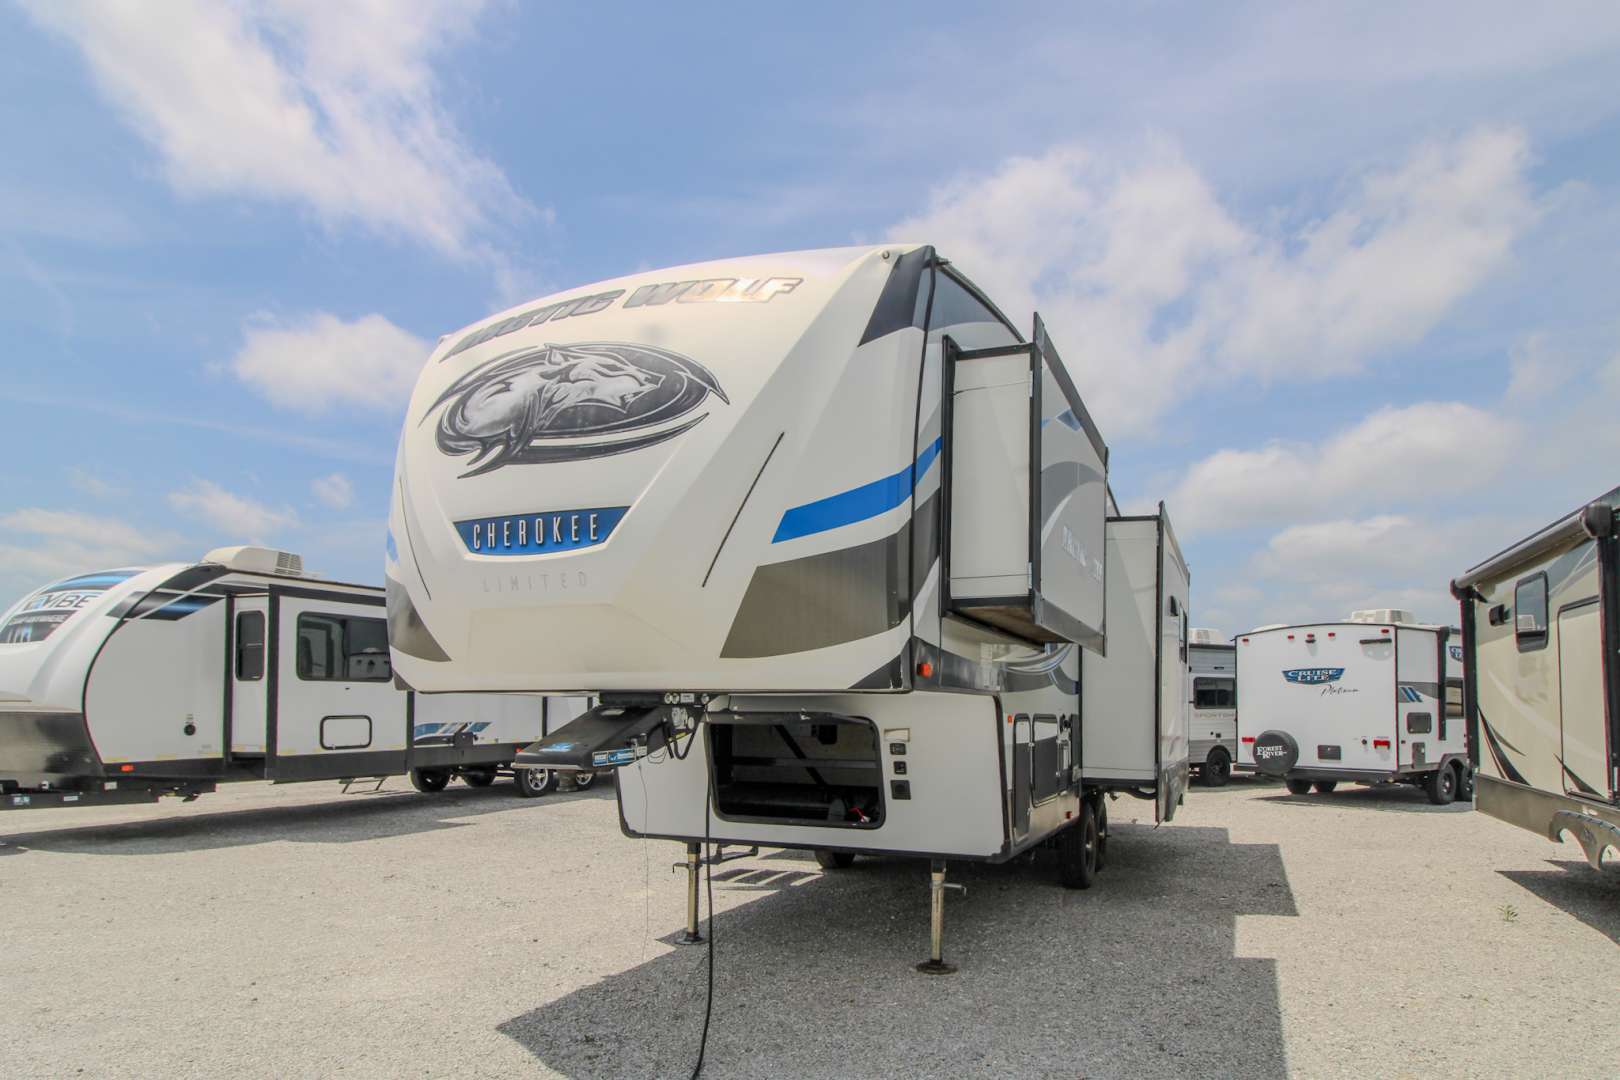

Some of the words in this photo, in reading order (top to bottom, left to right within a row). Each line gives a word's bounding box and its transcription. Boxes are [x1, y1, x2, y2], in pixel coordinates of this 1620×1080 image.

[622, 277, 804, 309] WOLF
[473, 513, 599, 549] CHEROKEE
[482, 570, 588, 593] LIMITED
[1287, 669, 1338, 677] CRUISE
[1256, 745, 1283, 756] FOREST
[1262, 750, 1284, 759] RIVER
